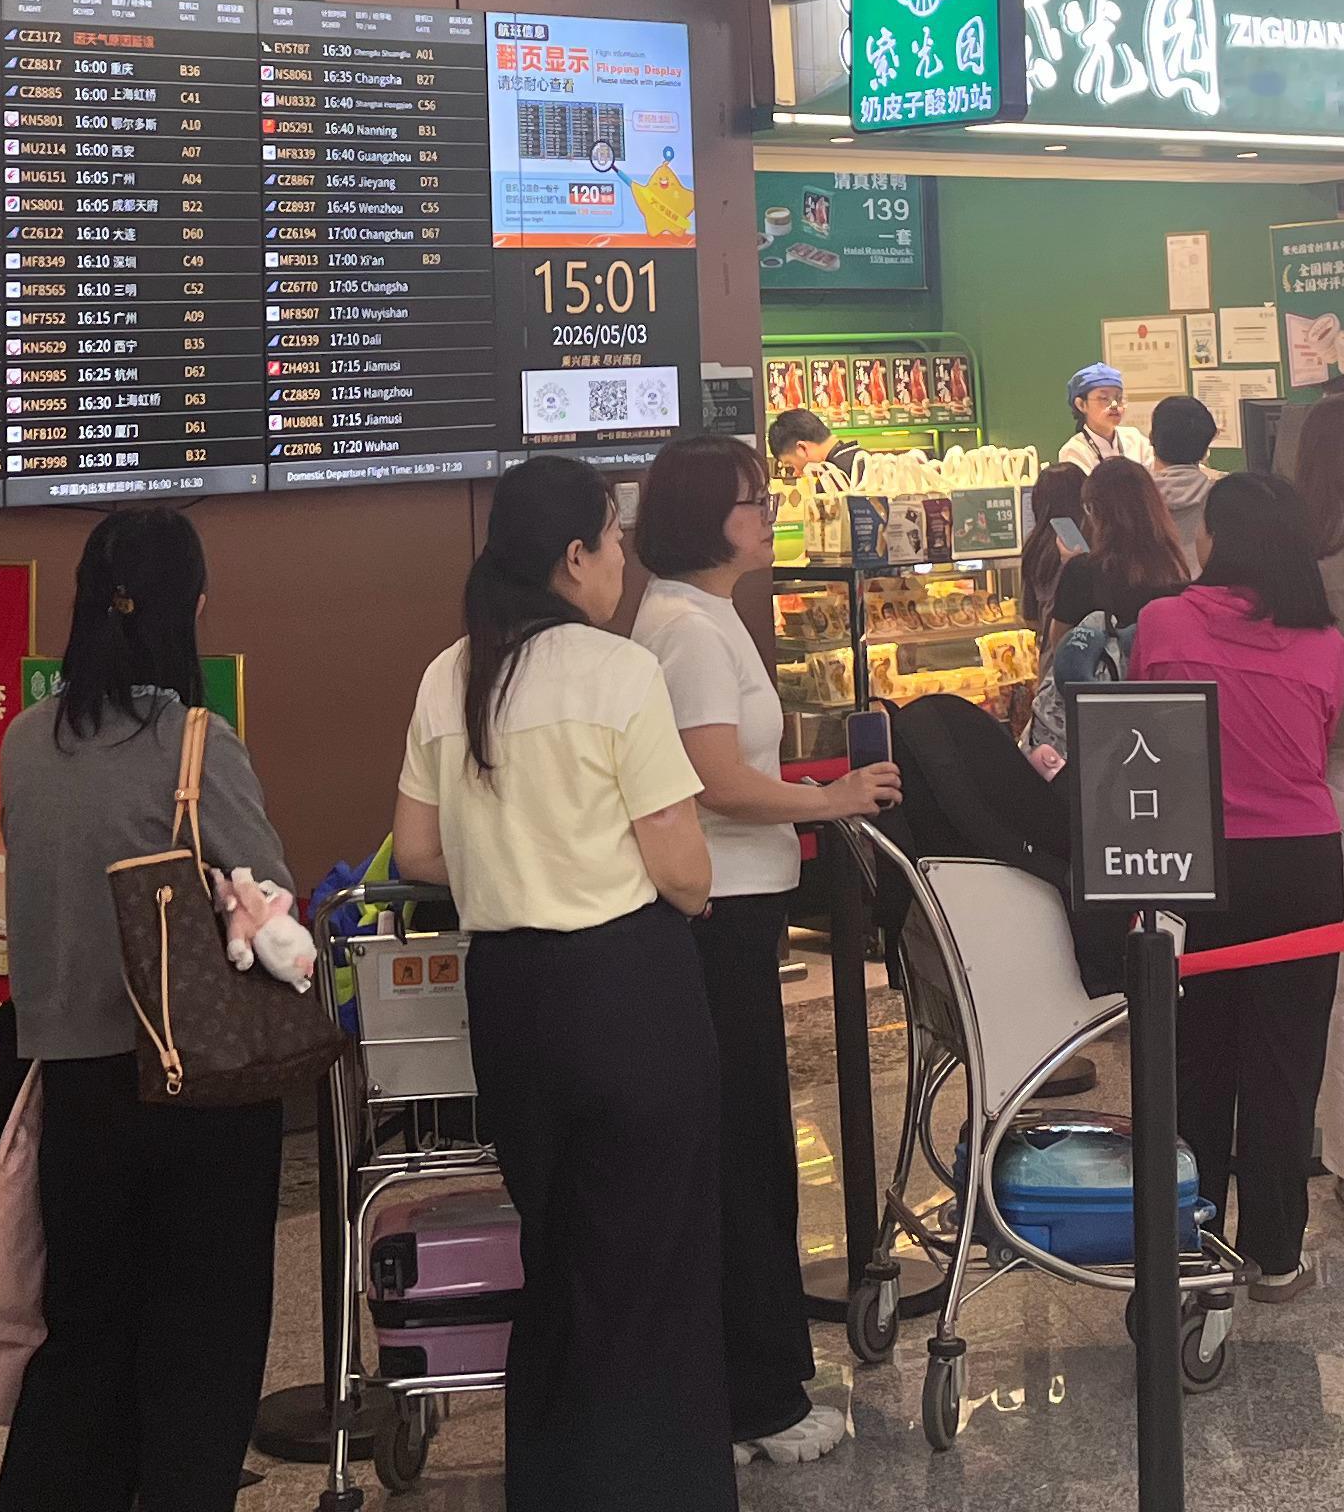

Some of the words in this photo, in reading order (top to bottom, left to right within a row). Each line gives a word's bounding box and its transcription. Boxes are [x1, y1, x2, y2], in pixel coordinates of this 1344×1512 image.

[497, 23, 546, 39] 航班信息
[496, 43, 590, 73] 翻页显示
[865, 15, 985, 92] 紫光园
[20, 58, 61, 70] CZ8817
[75, 60, 107, 73] 16:00
[596, 62, 640, 76] Flipping
[645, 64, 682, 78] Display
[324, 71, 352, 82] 16:35
[355, 73, 402, 87] Changsha
[498, 75, 575, 93] 请您耐心查看
[860, 82, 993, 124] 奶皮子酸奶站
[18, 143, 66, 154] MU2114
[76, 144, 108, 156] 16:00
[326, 149, 354, 161] 16:40
[358, 151, 411, 164] Guangzhou
[19, 171, 66, 182] MU6151
[76, 171, 108, 184] 16:05
[571, 186, 600, 203] 120
[862, 197, 910, 221] 139
[22, 227, 63, 239] CZ6122
[77, 227, 109, 240] 16:10
[878, 228, 913, 245] 一套
[534, 259, 657, 314] 15:01
[552, 324, 647, 348] 2026/05/03
[326, 467, 366, 481] Departure
[367, 466, 389, 478] Flight
[1122, 729, 1161, 820] 入口
[1104, 846, 1193, 882] Entry
